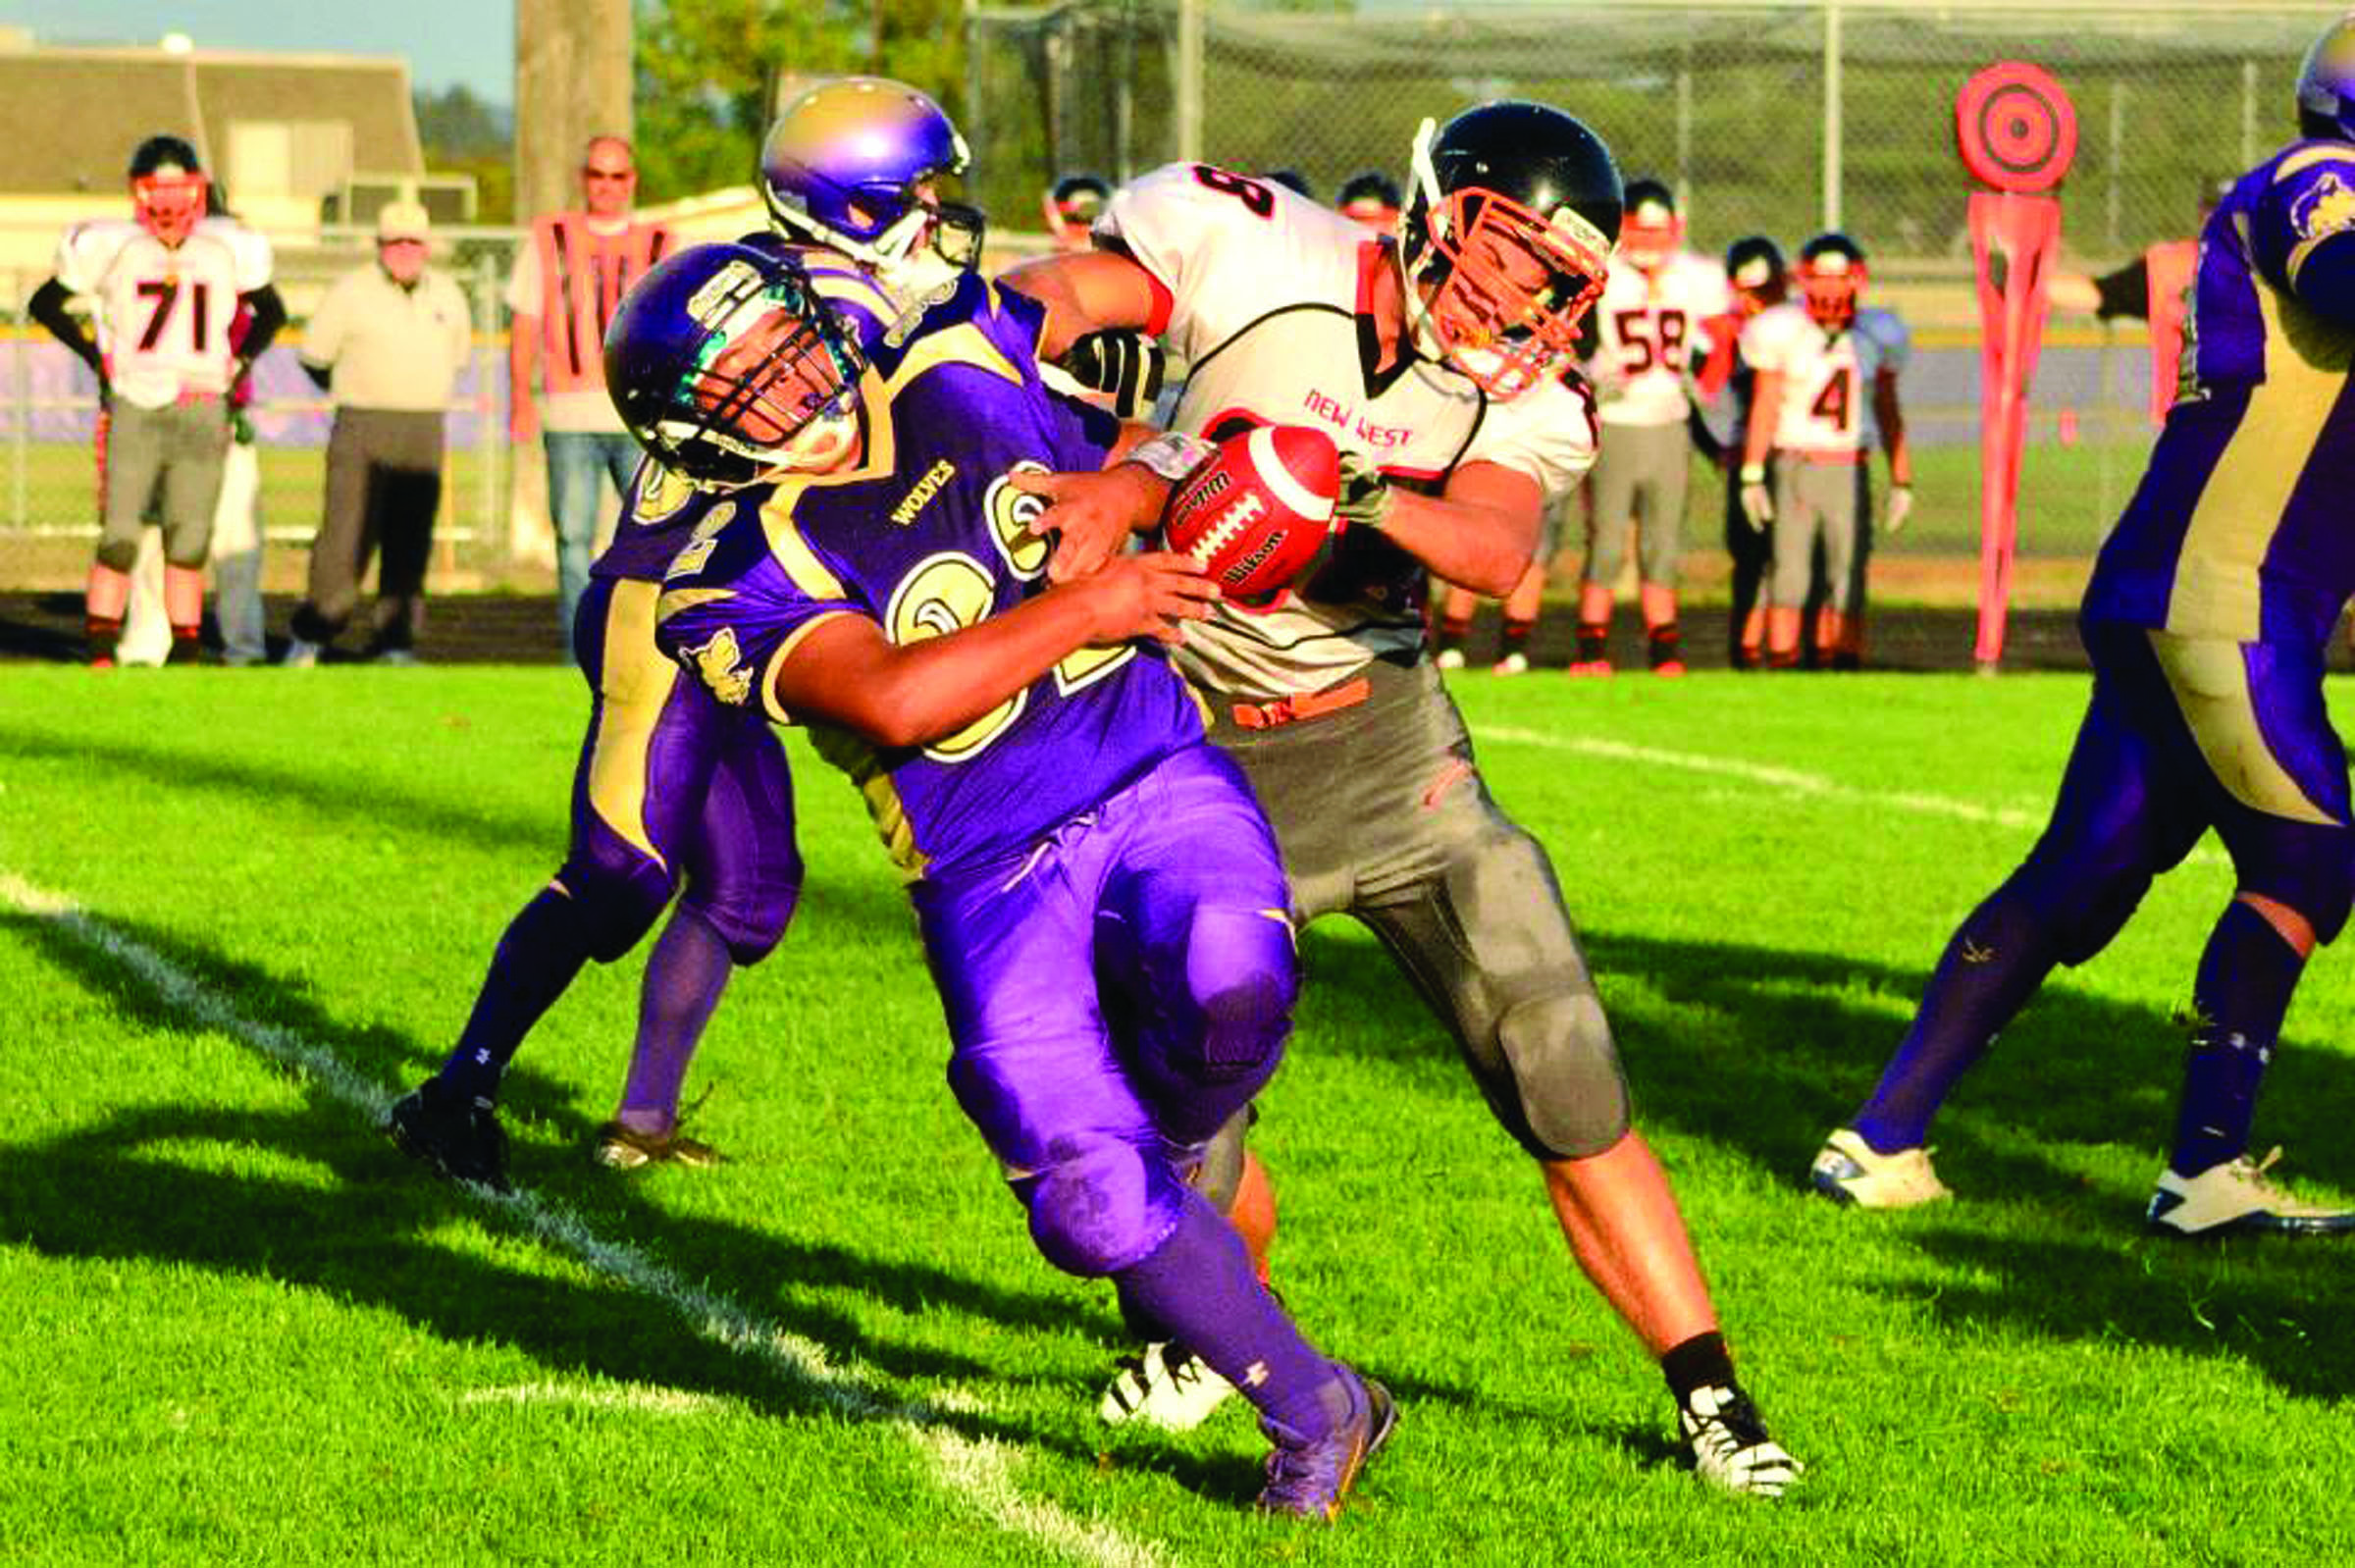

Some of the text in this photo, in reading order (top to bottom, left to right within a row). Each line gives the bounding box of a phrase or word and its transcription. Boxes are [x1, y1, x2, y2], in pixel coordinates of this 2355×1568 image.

[137, 283, 206, 351] 71
[1614, 308, 1686, 375] 58
[1303, 388, 1353, 428] NEW
[1811, 367, 1850, 432] 4
[890, 458, 956, 526] WOLVES
[1223, 531, 1285, 586] Wilson
